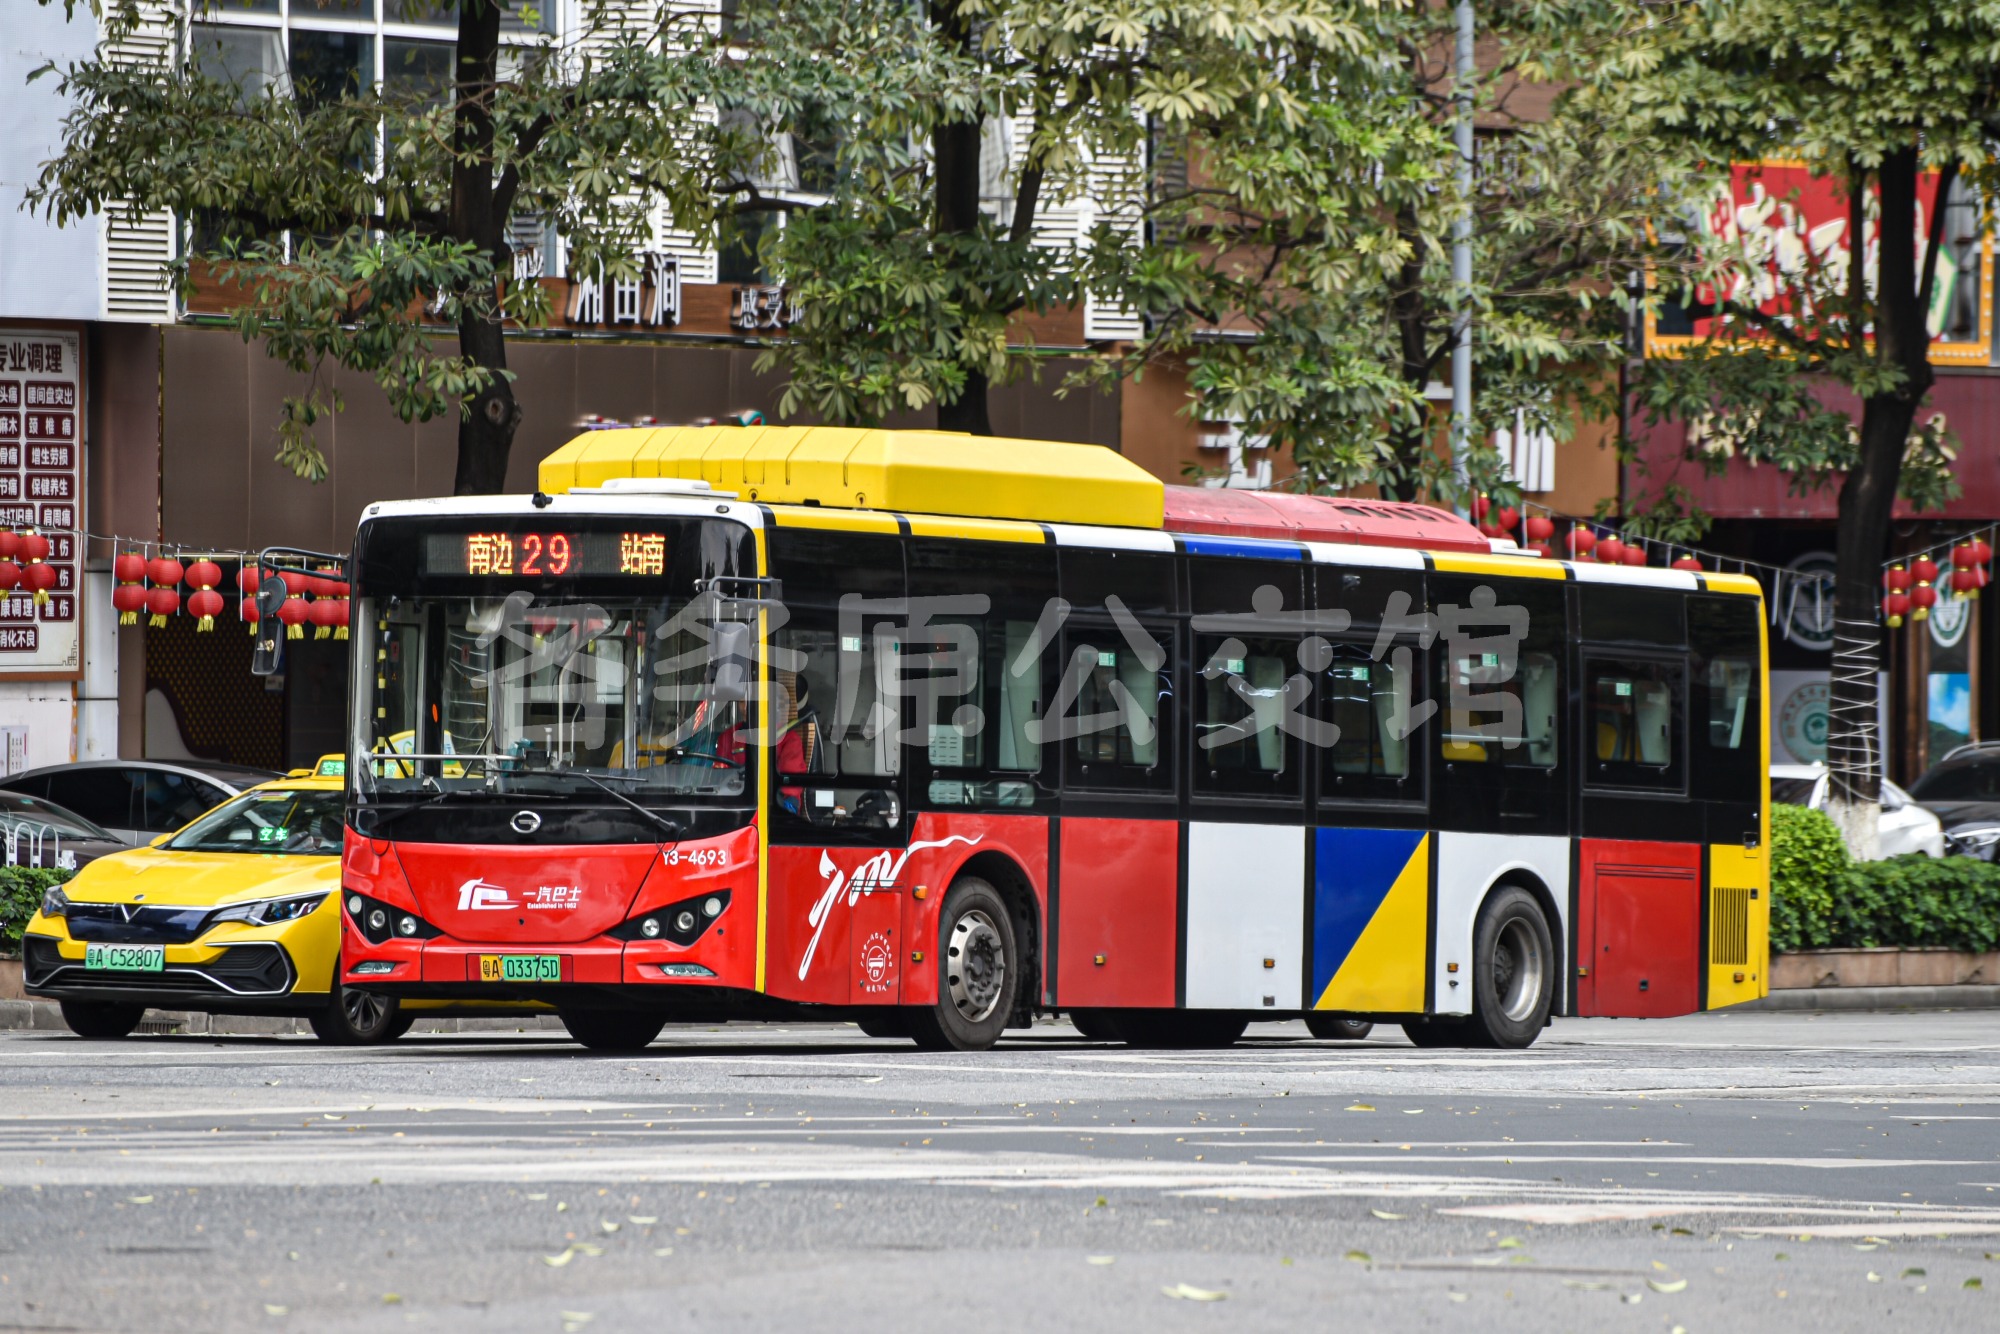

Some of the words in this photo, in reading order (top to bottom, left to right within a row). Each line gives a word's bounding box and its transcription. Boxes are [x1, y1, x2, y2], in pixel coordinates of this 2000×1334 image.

[28, 386, 73, 405] 腰间盘突出
[0, 416, 18, 434] 麻木
[32, 446, 68, 466] 增生劳损
[32, 477, 68, 496] 保健养生
[469, 533, 513, 575] 南边
[522, 534, 570, 575] 29
[620, 533, 666, 575] 站南
[663, 849, 727, 866] Y3-4693
[522, 886, 582, 903] 一汽巴士
